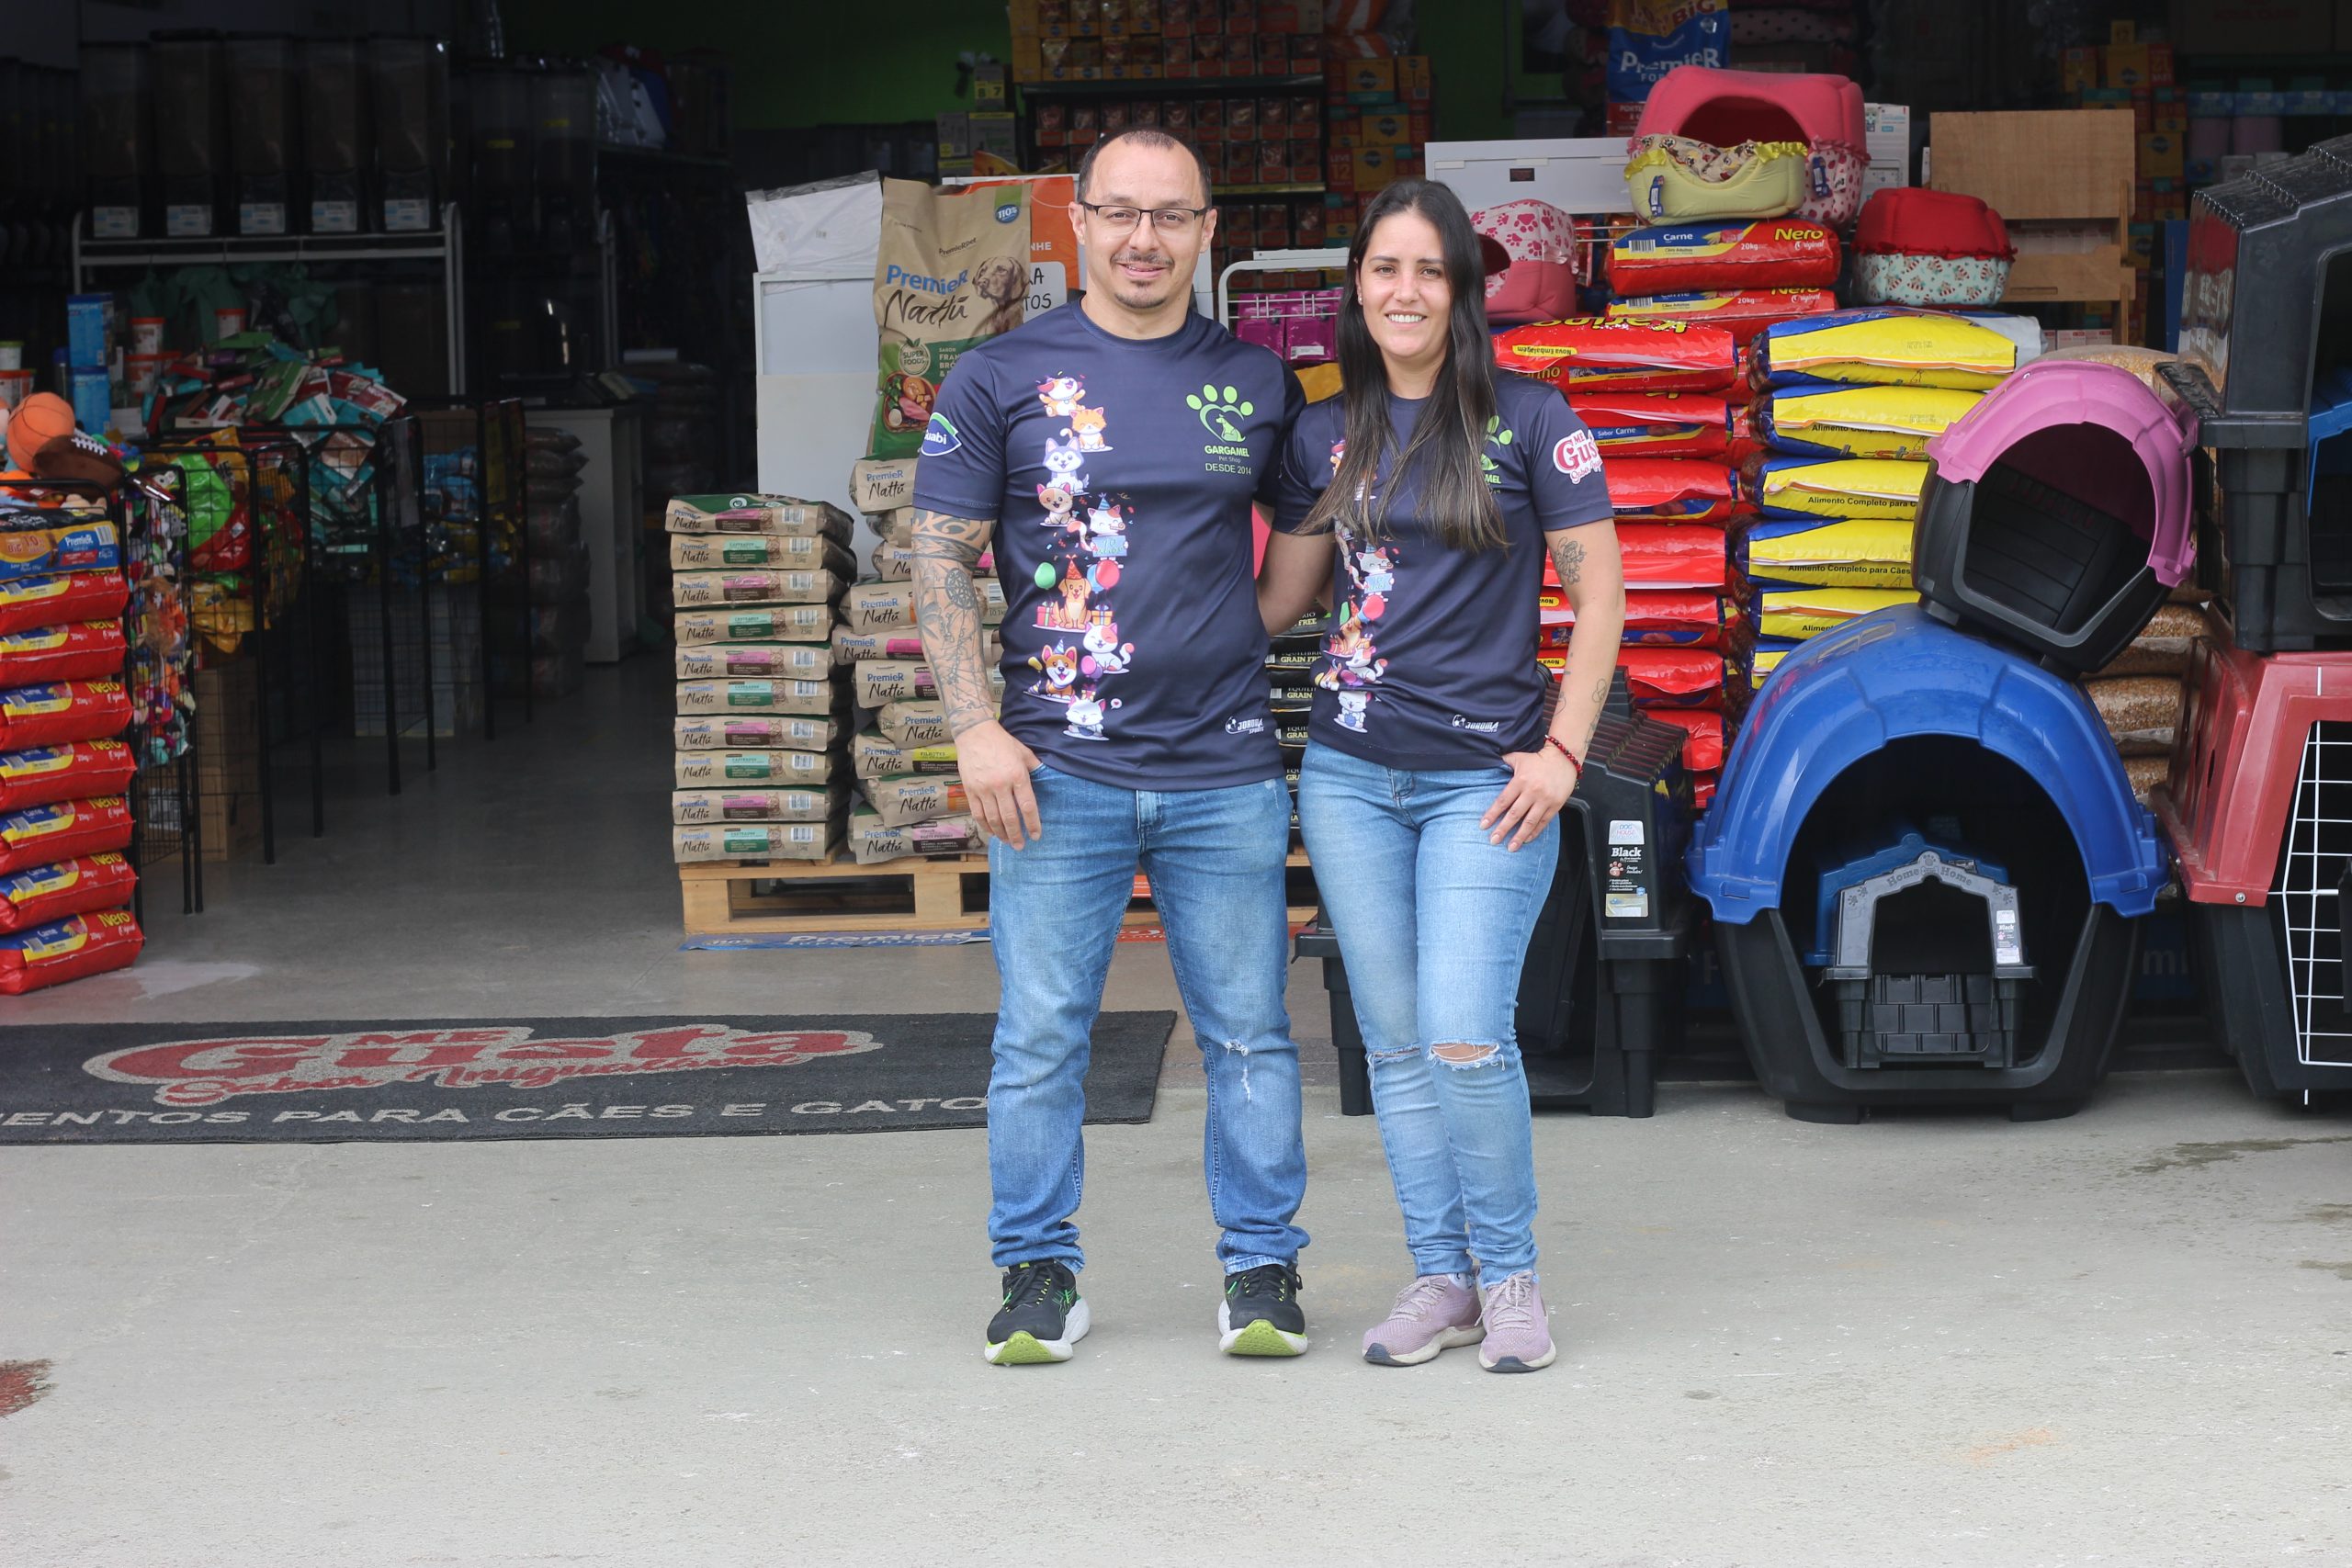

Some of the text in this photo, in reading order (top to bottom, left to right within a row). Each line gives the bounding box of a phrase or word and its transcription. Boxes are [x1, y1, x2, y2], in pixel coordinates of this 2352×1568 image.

[1663, 232, 1693, 241] Carne
[1774, 228, 1824, 241] Nero
[1030, 242, 1052, 250] NHE
[886, 265, 969, 295] PremieR
[884, 289, 969, 328] Nattú
[1553, 347, 1572, 355] Nova
[1615, 426, 1636, 435] Carne
[924, 430, 947, 445] uabi
[1575, 432, 1586, 445] ME
[1204, 446, 1250, 457] GARGAMEL
[1556, 441, 1597, 470] Gus
[866, 469, 903, 481] PremieR
[1205, 463, 1251, 475] DESDE 2014
[868, 480, 906, 500] Nattú
[1848, 498, 1887, 507] Completo
[861, 598, 899, 608] PremieR
[863, 608, 899, 626] Nattú
[1298, 618, 1317, 626] FREE
[841, 637, 876, 648] PremieR
[867, 672, 904, 682] PremieR
[87, 682, 120, 694] Nero
[869, 683, 904, 698] Nattú
[905, 716, 943, 725] PremieR
[906, 727, 943, 741] Nattú
[866, 758, 903, 772] Nattú
[899, 786, 936, 796] PremieR
[900, 797, 938, 815] Nattú
[866, 840, 902, 856] Nattú
[1611, 847, 1642, 857] Black
[91, 852, 122, 865] Nero
[1887, 866, 1973, 886] Home Home
[98, 912, 130, 928] Nero
[356, 1030, 510, 1045] ME
[107, 1027, 856, 1079] Gusta
[164, 1076, 380, 1104] Sabor
[0, 1097, 988, 1127] ENTOS PARA CÃES E GATO
